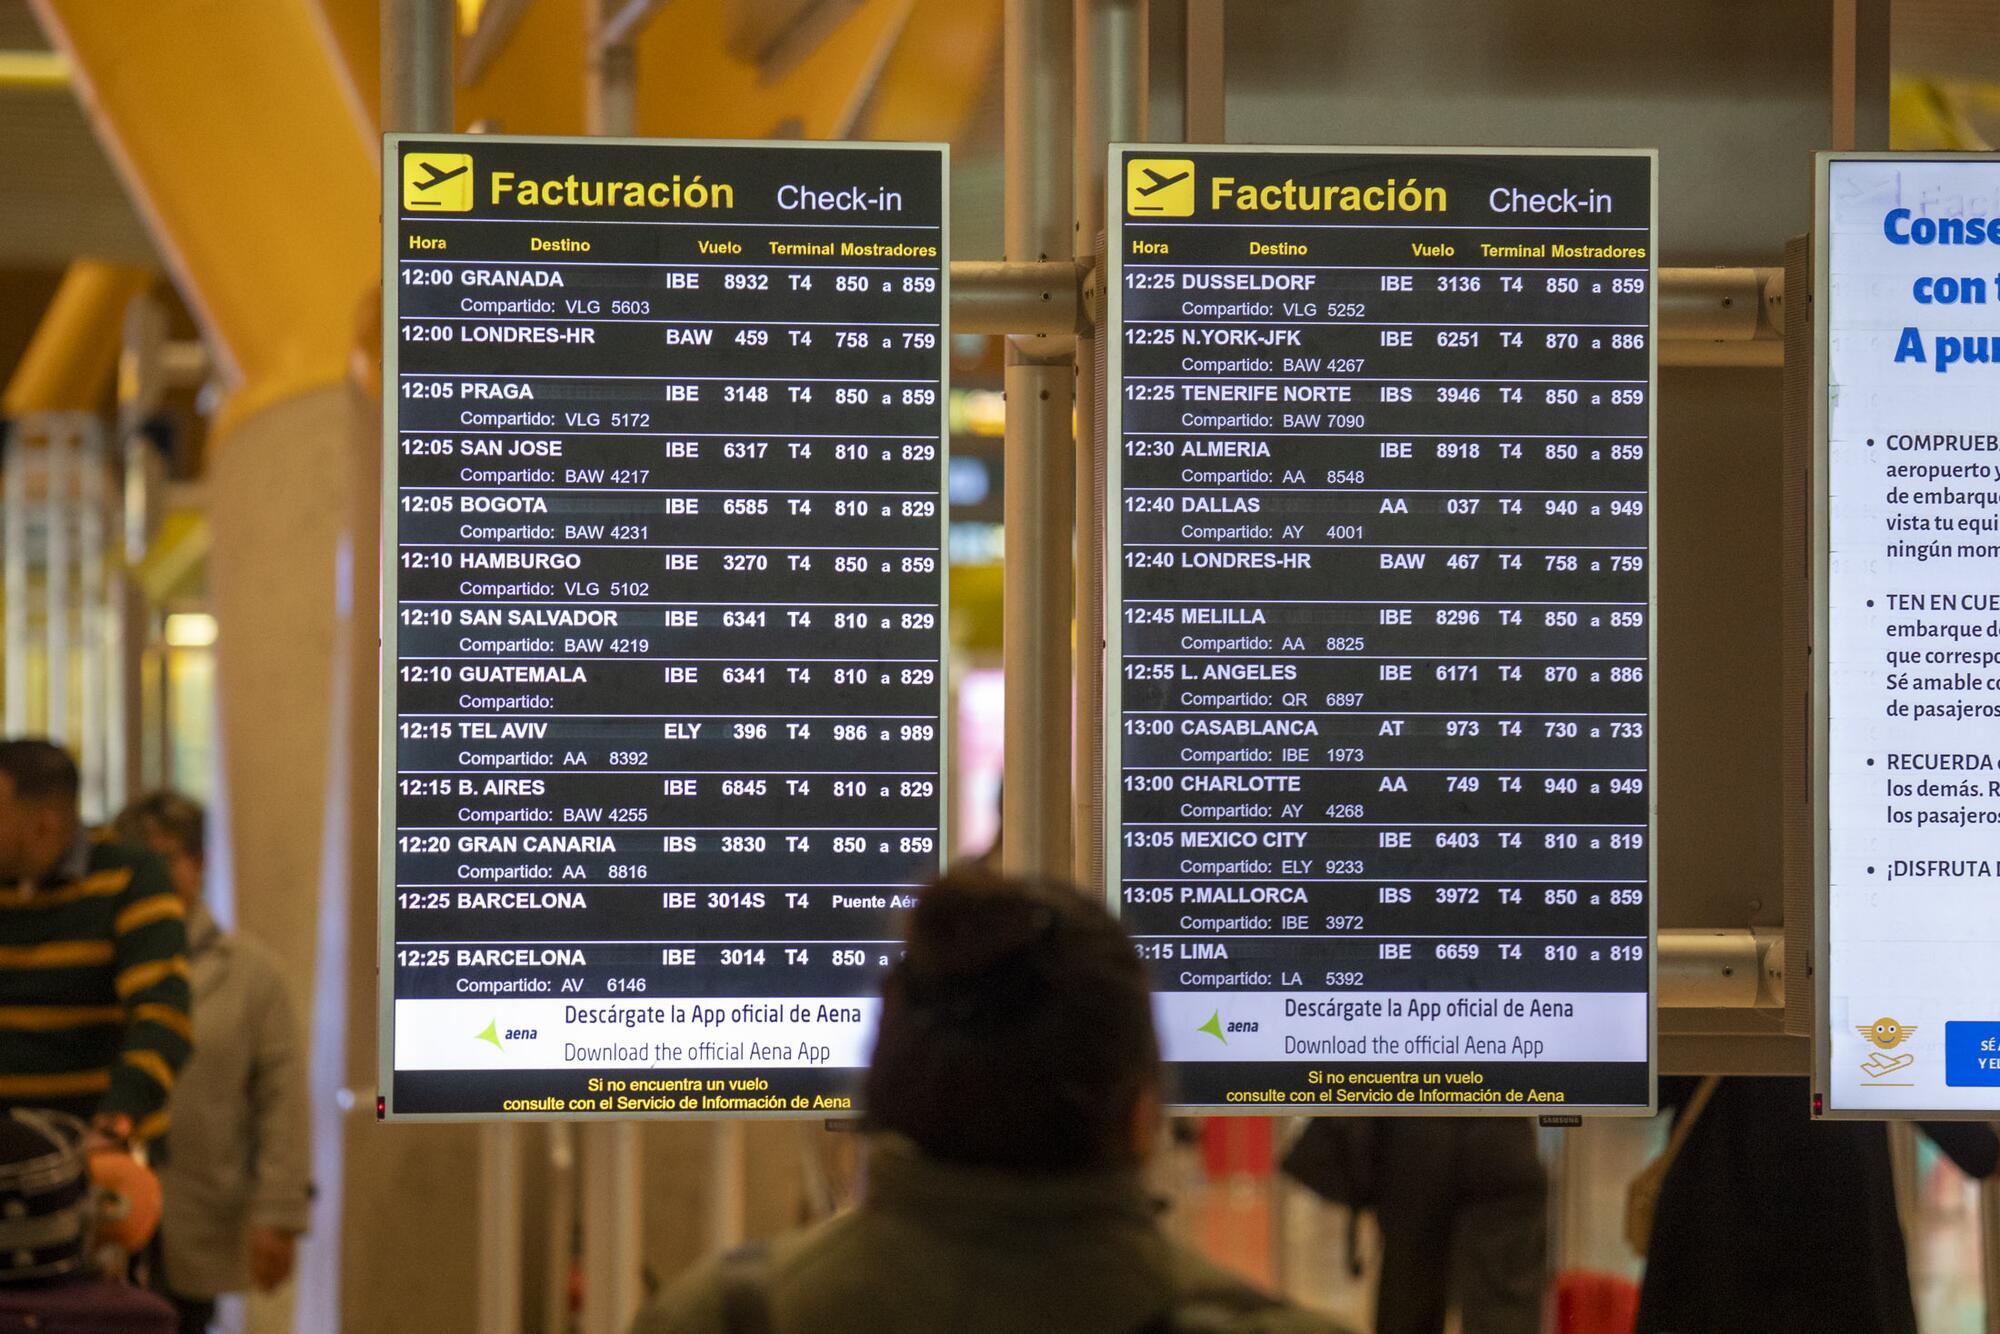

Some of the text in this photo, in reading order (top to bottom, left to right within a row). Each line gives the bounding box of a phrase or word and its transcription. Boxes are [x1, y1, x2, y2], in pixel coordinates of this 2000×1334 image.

[491, 171, 734, 209] Facturación
[777, 184, 902, 211] Check-in
[1211, 176, 1447, 212] Facturación
[1489, 187, 1612, 213] Check-in
[409, 235, 937, 257] Hora Destino Vuelo Terminal Mostradores
[1132, 240, 1646, 259] Hora Destino Vuelo Terminal Mostradores
[401, 268, 936, 293] 12:00 GRANADA IBE 8932 T4 850 a 859
[1912, 276, 1987, 305] con
[460, 297, 650, 316] Compartido: VLG 5603
[1125, 328, 1644, 350] 12:25 N.YORK-JFK IBE 6251 T4 870 a 886
[1893, 326, 1927, 363] A
[1181, 357, 1365, 375] Compartido: BAW 4267
[1886, 434, 2000, 452] COMPRUEB
[1886, 462, 1991, 482] aeropuerto
[1886, 486, 2000, 509] de embarqu
[1886, 512, 1998, 536] vista tu equi
[1887, 539, 1952, 562] ningún
[1886, 594, 2000, 611] TEN EN CUE
[1886, 619, 1983, 642] embarque
[1886, 651, 1921, 668] que
[1886, 672, 1909, 690] Sé
[1912, 672, 1983, 691] amable
[1886, 698, 1909, 717] de
[399, 722, 934, 742] 12:15 TEL AVIV ELY 396 T4 986 a 989
[1124, 719, 1643, 739] 13:00 CASABLANCA AT 973 T4 730 a 733
[458, 751, 648, 769] Compartido: AA 8392
[1180, 747, 1364, 765] Compartido: IBE 1973
[1887, 753, 1994, 771] RECUERDA
[1887, 778, 1913, 797] los
[1916, 778, 1984, 797] demás.
[1887, 805, 1913, 824] los
[1887, 860, 1992, 882] ¡DISFRUTA
[398, 892, 451, 910] 12:25
[457, 892, 587, 909] BARCELONA
[663, 892, 697, 909] IBE
[707, 892, 766, 909] 3014S
[784, 892, 810, 909] T4
[832, 894, 887, 909] Puente
[1135, 943, 1643, 962] 3:15 LIMA IBE 6659 T4 810 a 819
[1179, 971, 1364, 989] Compartido: LA 5392
[565, 1003, 861, 1028] Descárgate la App oficial de Aena
[1285, 997, 1574, 1022] Descárgate la App oficial de Aena
[504, 1029, 538, 1040] aena
[1226, 1021, 1259, 1033] aena
[564, 1041, 830, 1065] Download the official Aena App
[1980, 1036, 1997, 1052] SÉ
[1978, 1057, 1988, 1070] Y
[587, 1076, 769, 1092] Si no encuentra un vuelo
[1308, 1070, 1484, 1084] Si no encuentra un vuelo
[503, 1094, 851, 1111] consulte con el Servicio de Información de Aena
